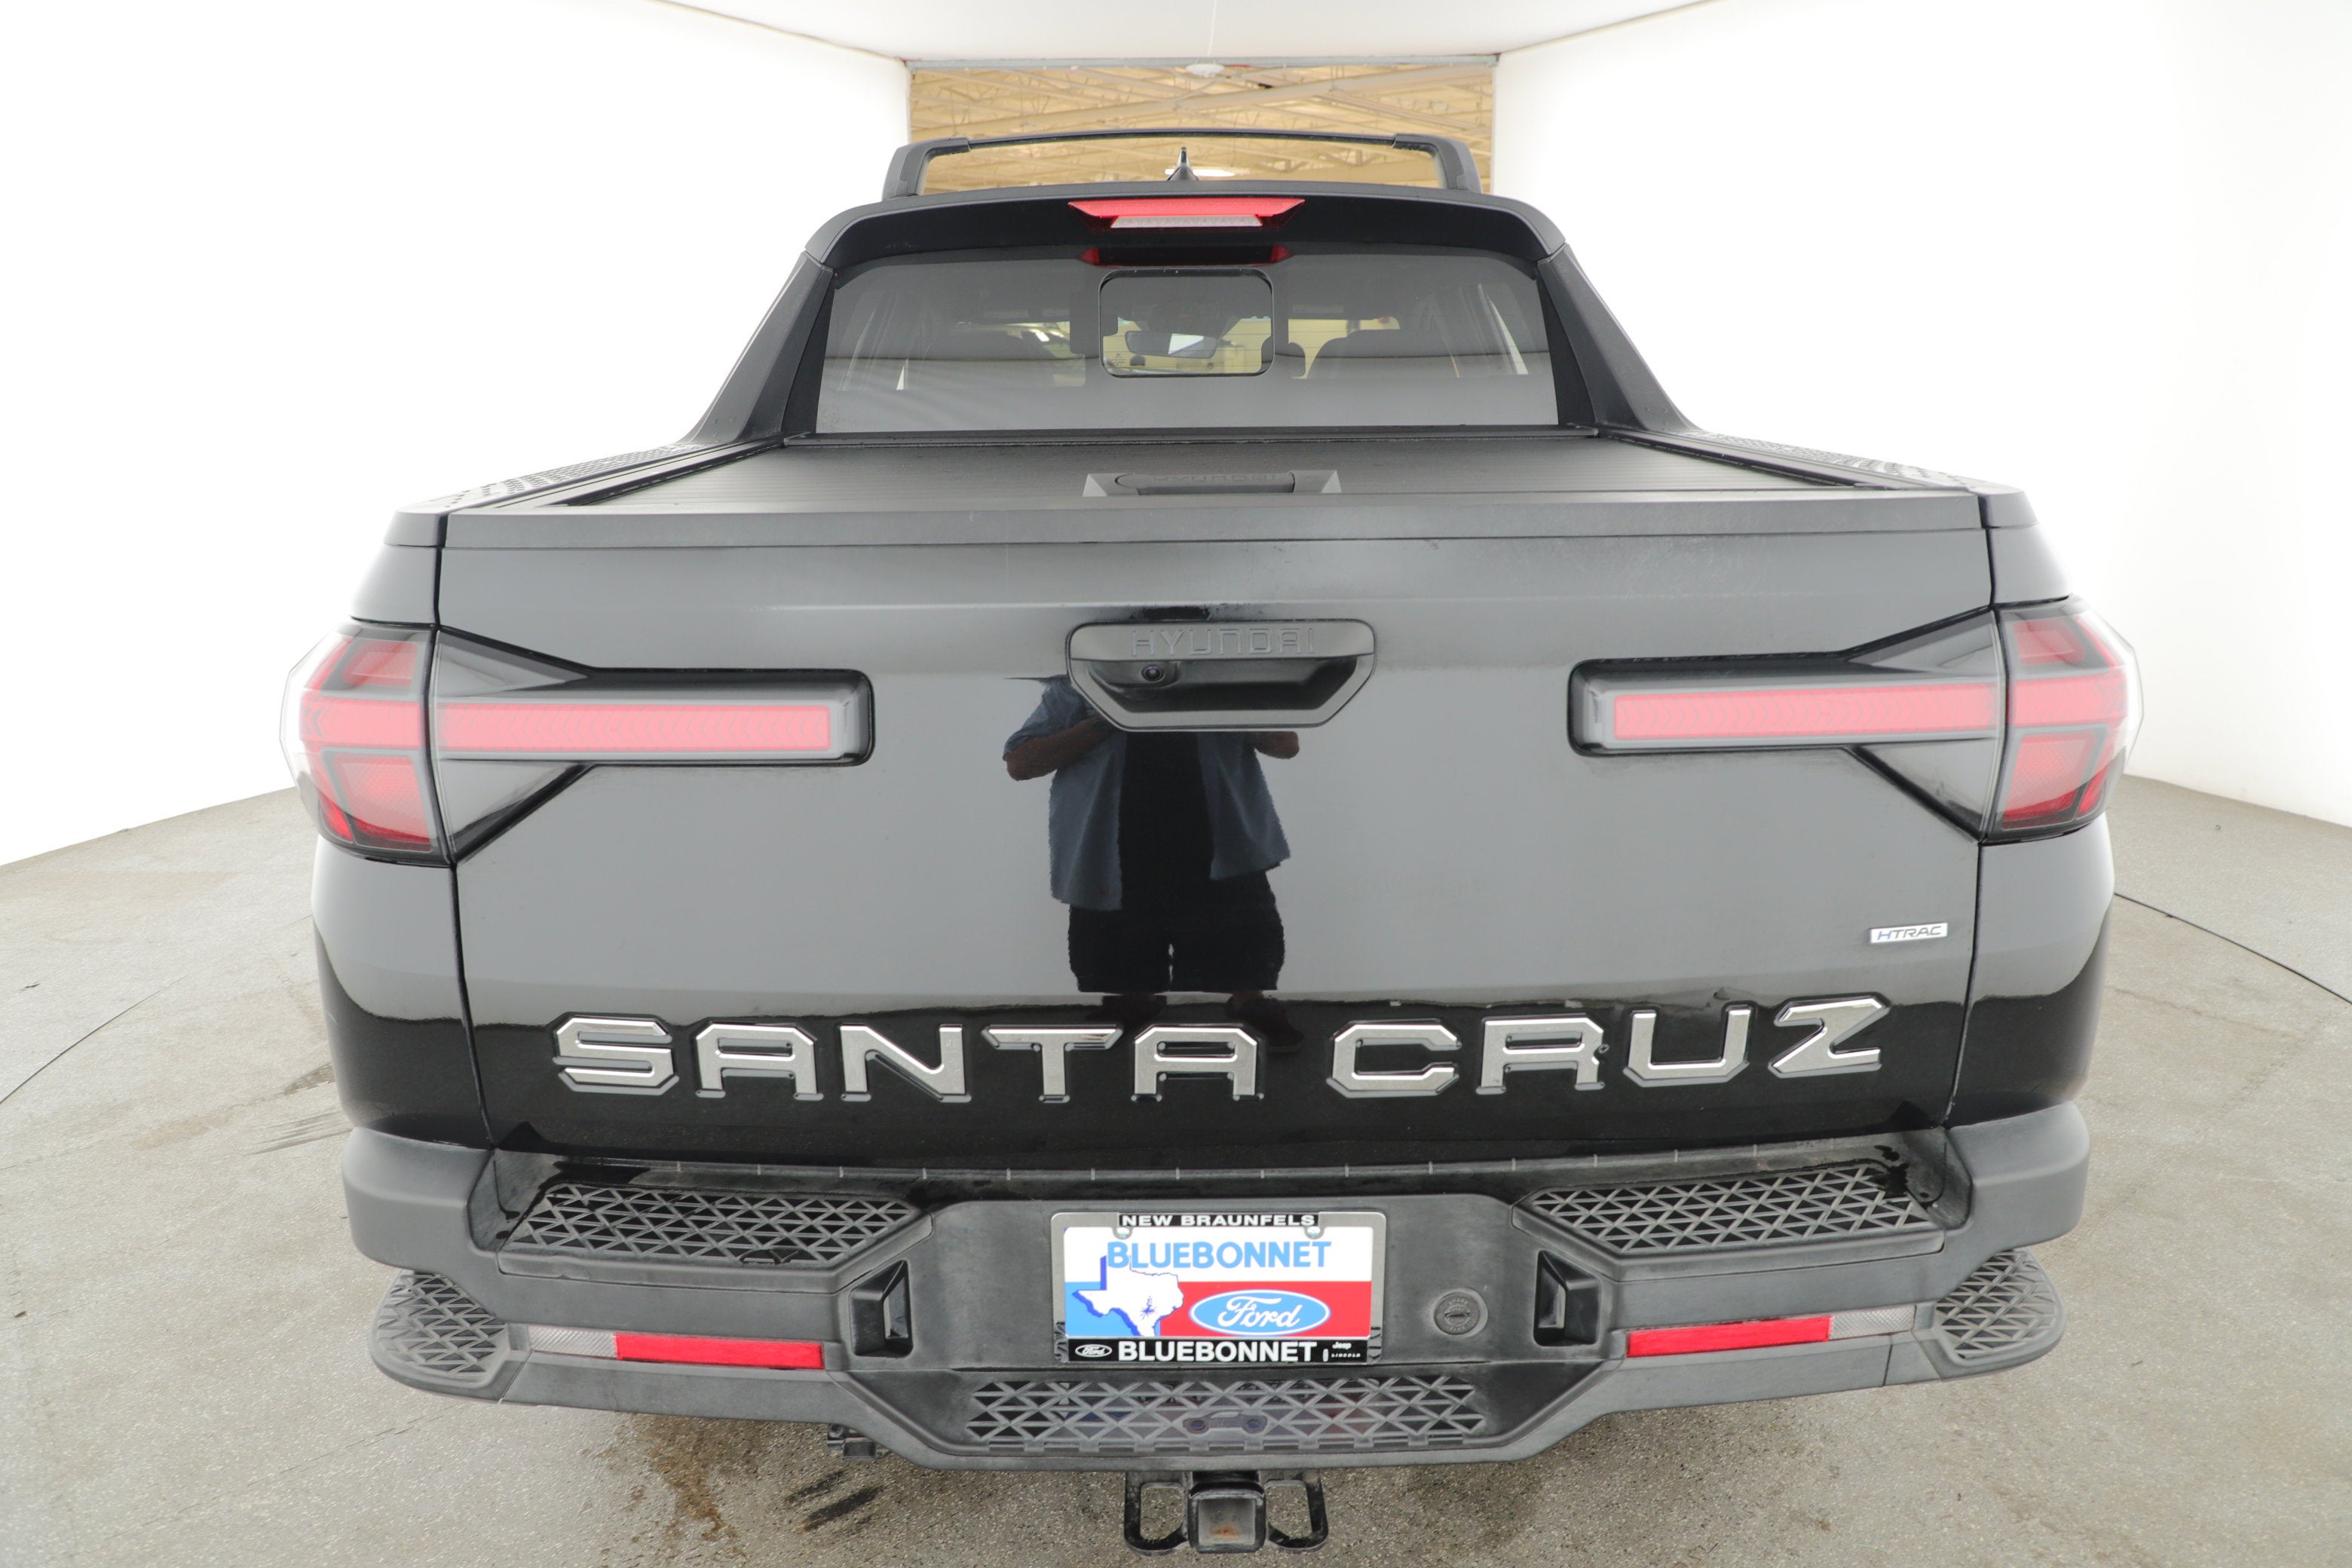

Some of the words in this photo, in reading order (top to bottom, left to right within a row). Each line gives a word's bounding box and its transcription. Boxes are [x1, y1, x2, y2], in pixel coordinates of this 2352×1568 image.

[1132, 626, 1317, 657] HYUNDAI
[1877, 926, 1942, 940] HTRAC
[553, 1013, 1263, 1104] SANTA
[1328, 994, 1888, 1098] CRUZ
[1122, 1214, 1173, 1227] NEW
[1181, 1214, 1315, 1227] BRAUNFELS
[1107, 1241, 1332, 1269] BLUEBONNET
[1217, 1294, 1301, 1328] Ford
[1118, 1340, 1318, 1361] BLUEBONNET
